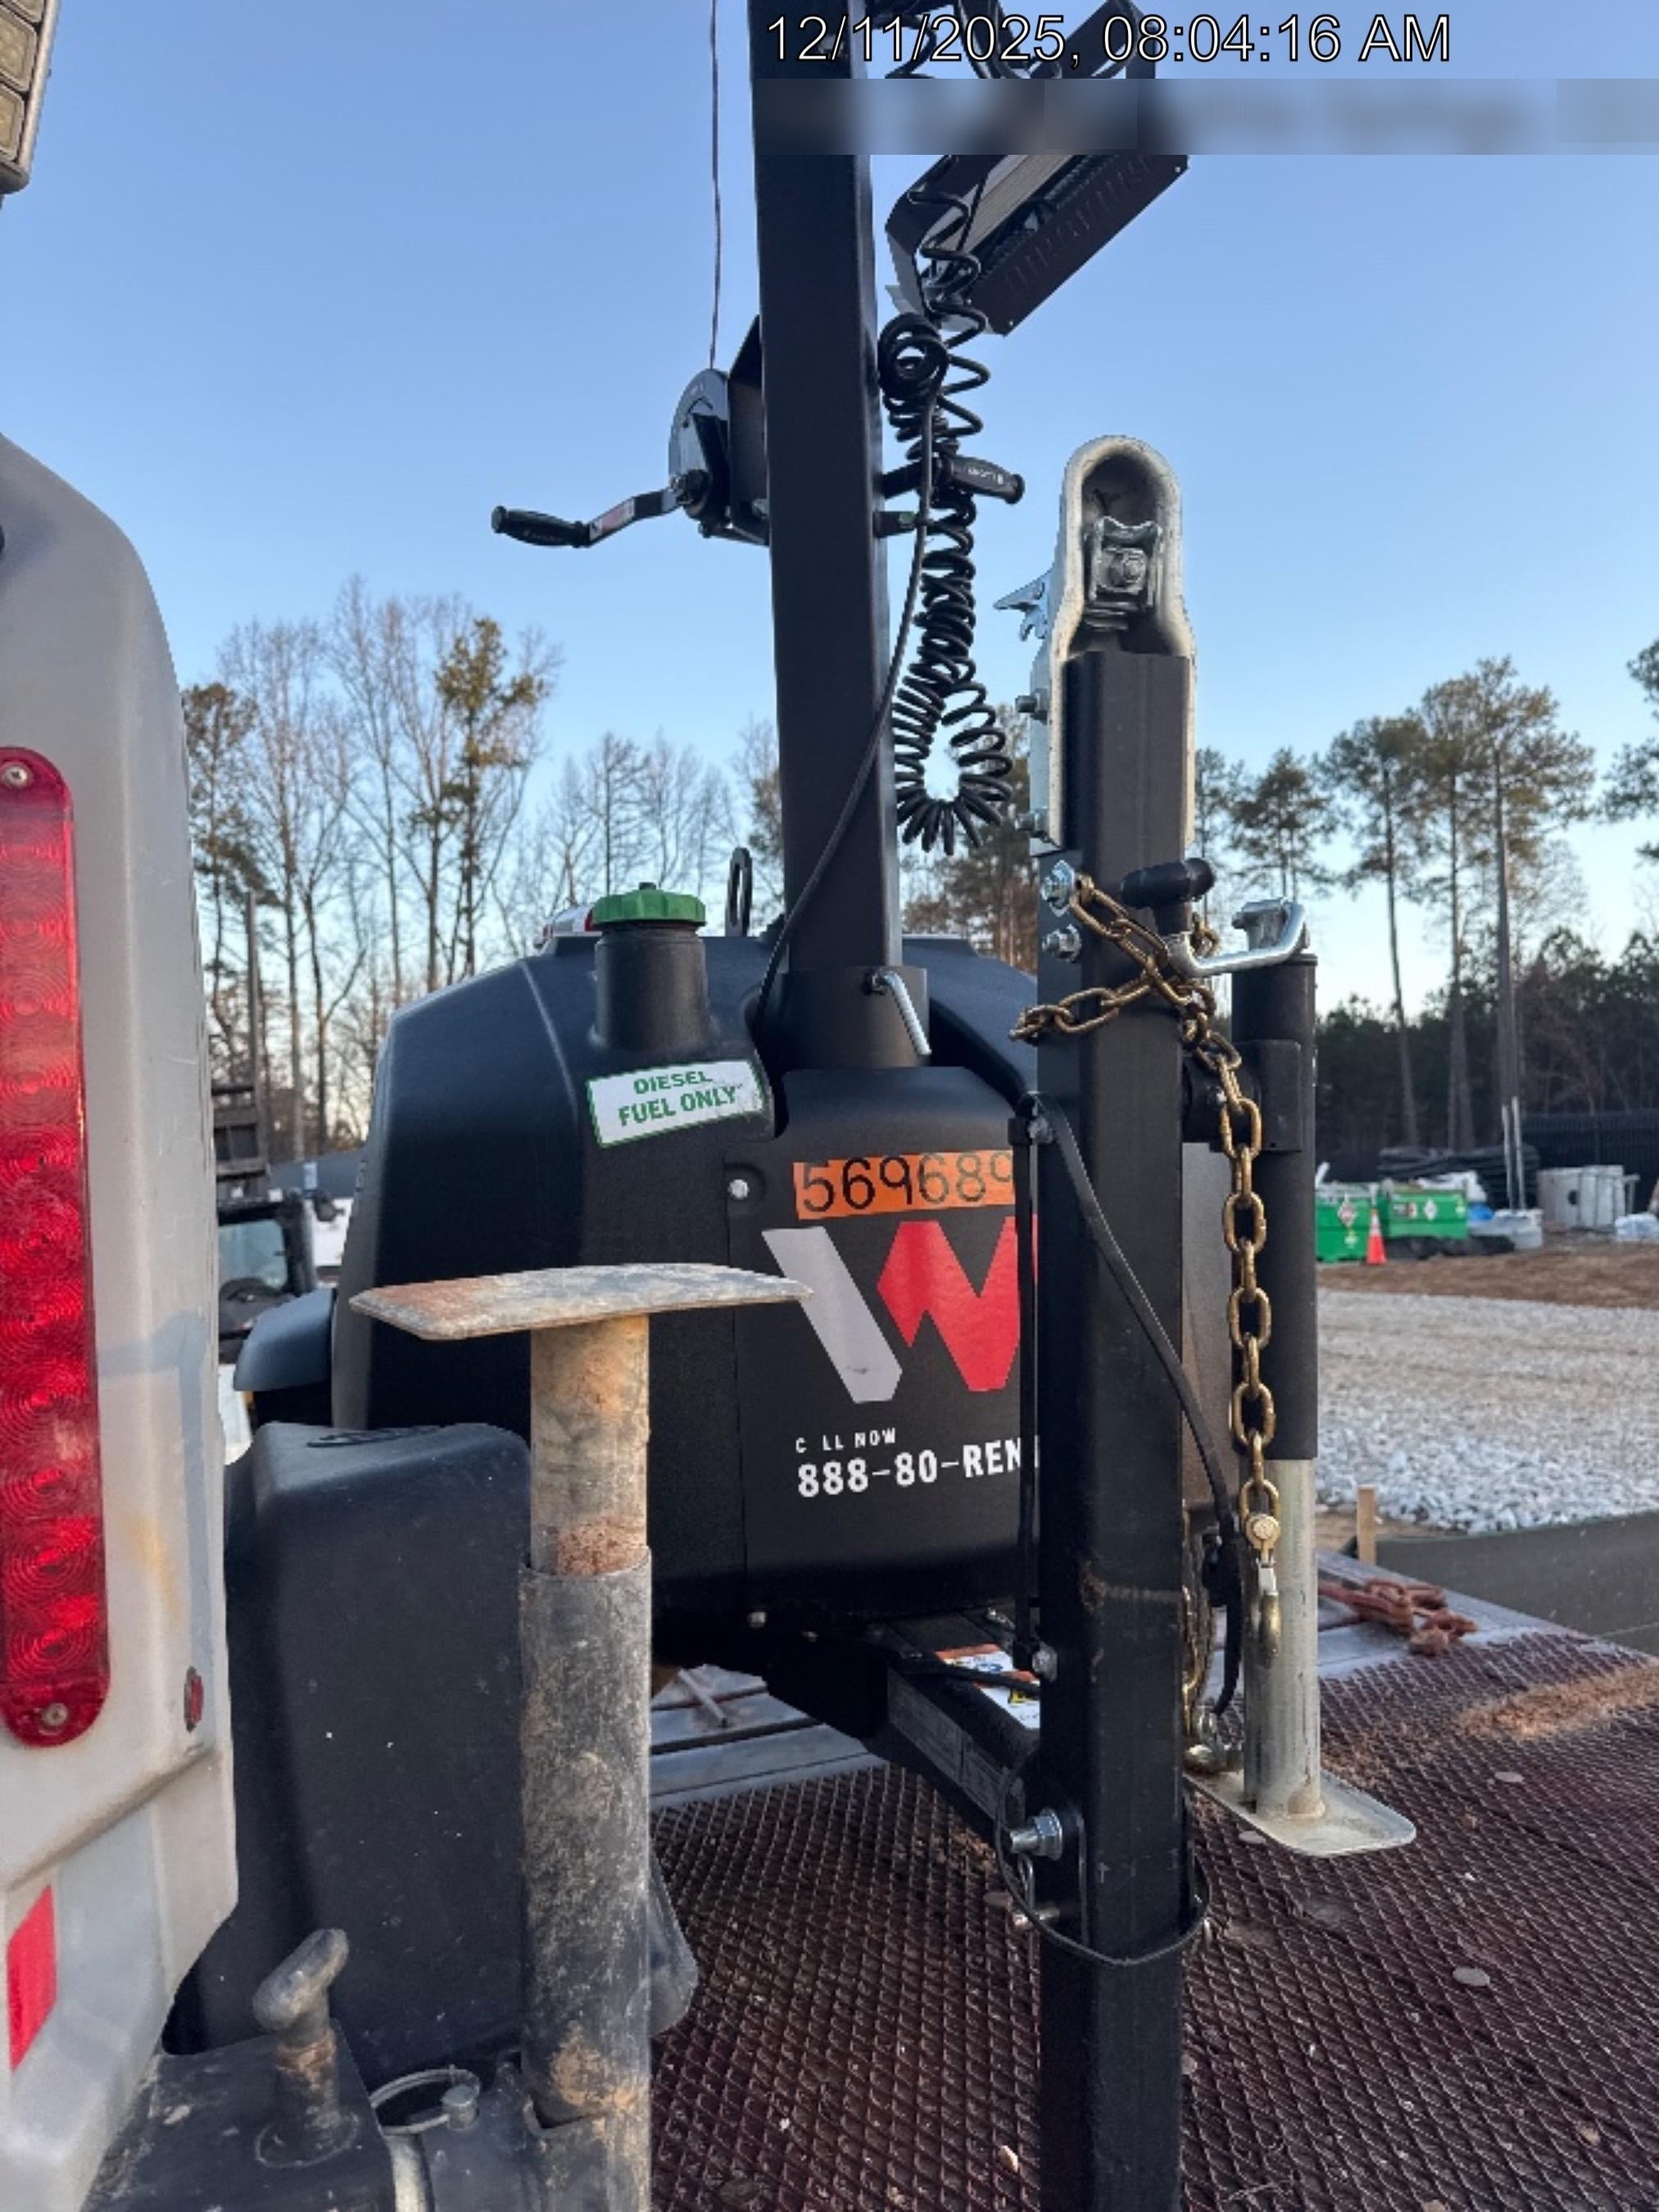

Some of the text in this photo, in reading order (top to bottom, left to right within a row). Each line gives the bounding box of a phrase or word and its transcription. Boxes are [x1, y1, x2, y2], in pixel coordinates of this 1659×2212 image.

[632, 1071, 713, 1095] DIESEL
[619, 1085, 737, 1126] FUEL ONLY
[795, 1427, 896, 1454] CLL NOW
